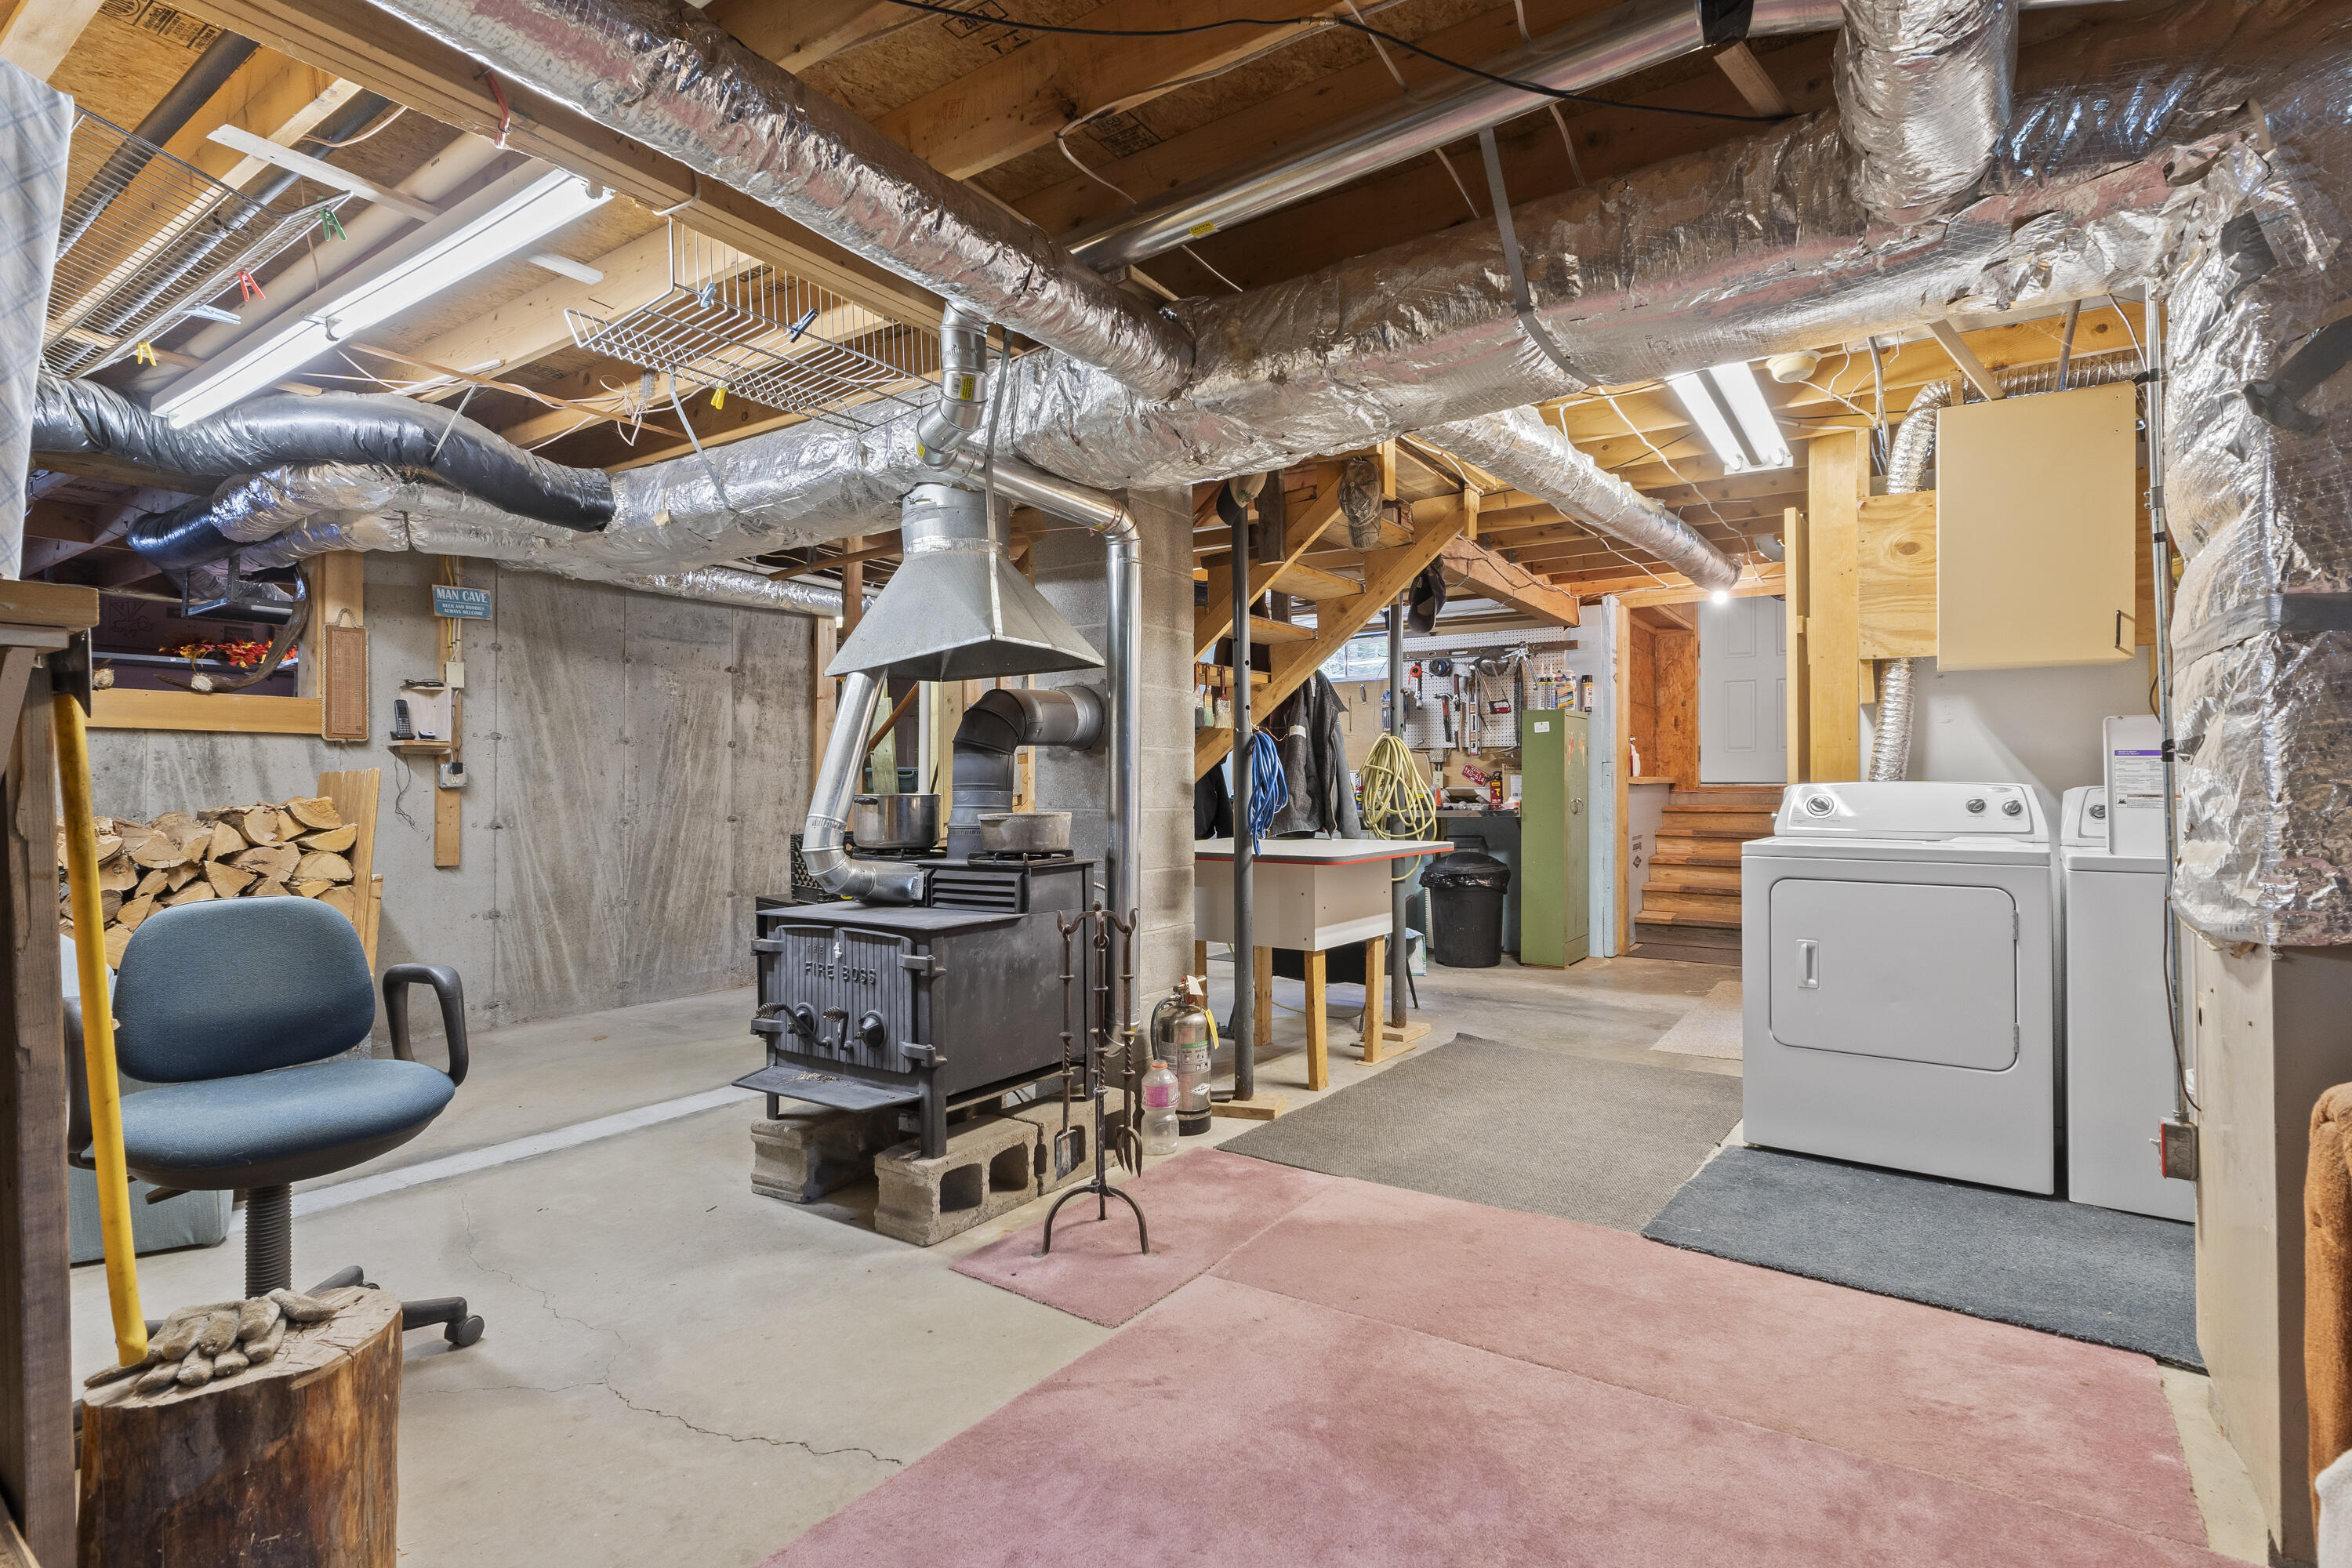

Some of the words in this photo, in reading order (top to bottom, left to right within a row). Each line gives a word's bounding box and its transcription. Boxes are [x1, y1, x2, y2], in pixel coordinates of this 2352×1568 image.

[436, 587, 459, 601] MAN
[462, 590, 488, 603] CAVE
[805, 943, 824, 955] THE
[804, 961, 835, 980] FIRE
[842, 965, 877, 985] BOSS
